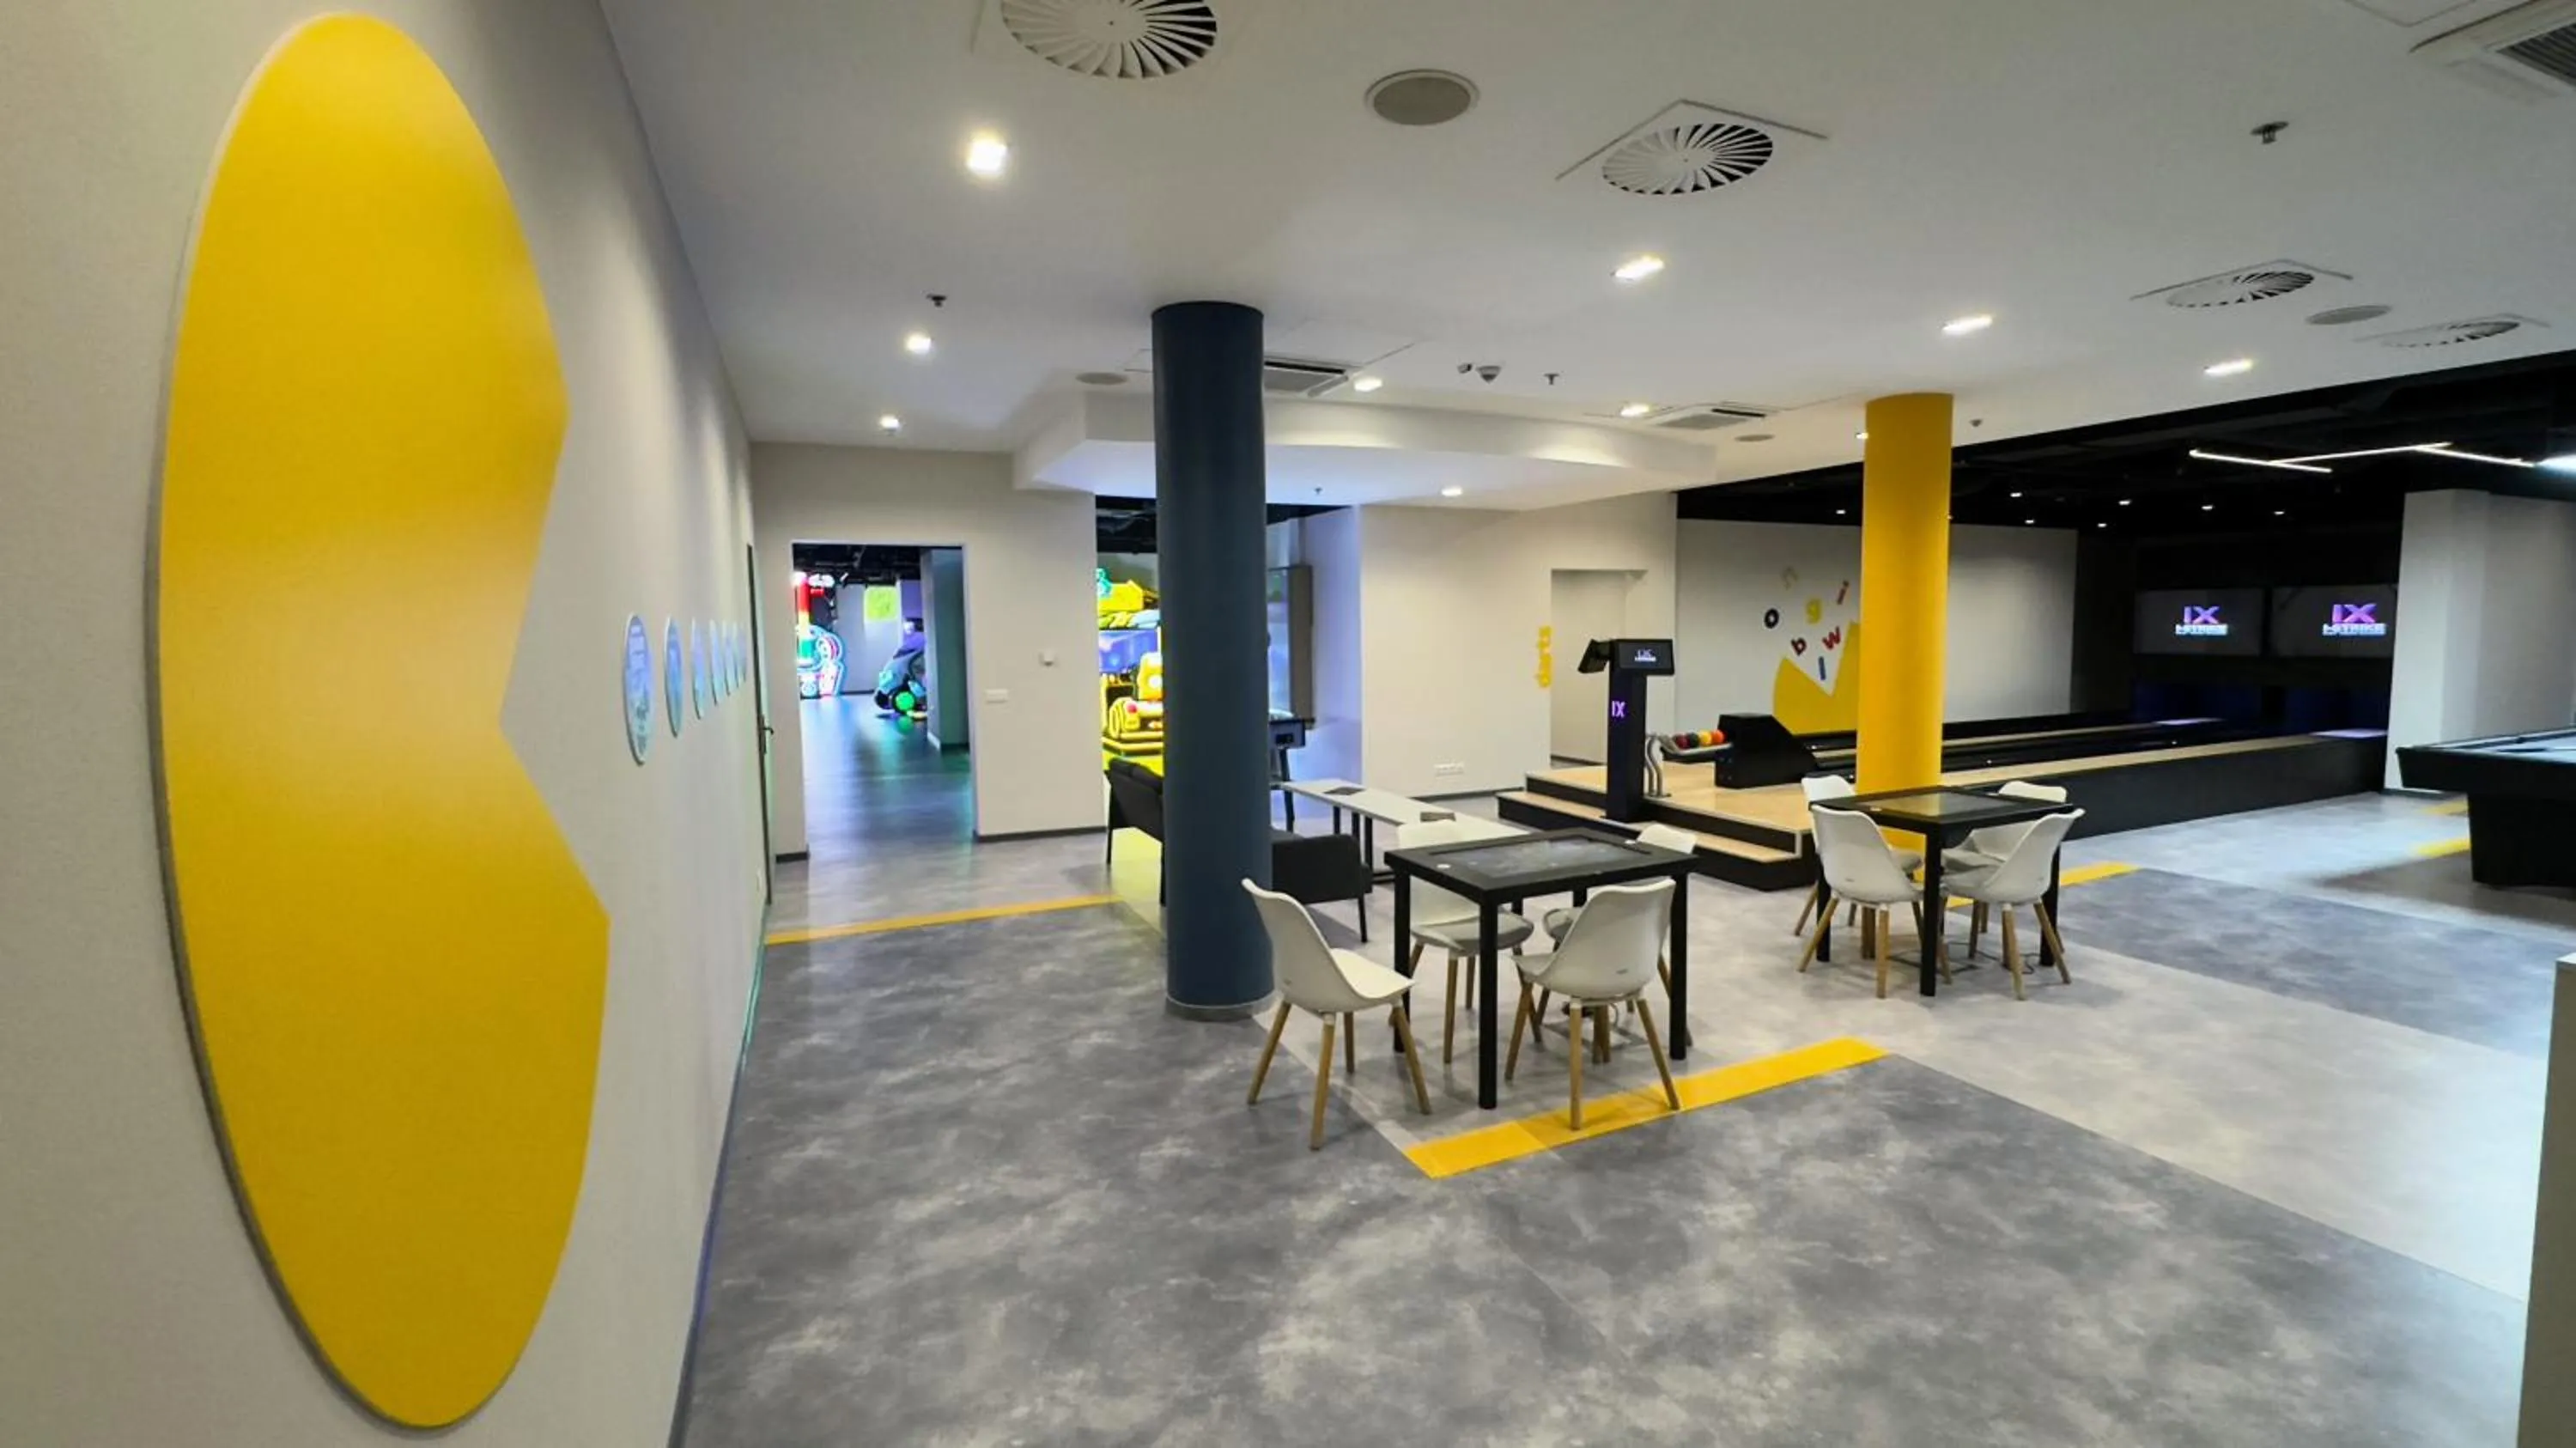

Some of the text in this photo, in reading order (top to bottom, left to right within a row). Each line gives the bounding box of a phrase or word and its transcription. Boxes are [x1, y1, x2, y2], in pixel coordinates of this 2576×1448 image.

[1837, 580, 1850, 605] i
[2184, 605, 2220, 625] IX
[2331, 603, 2377, 624] IX
[1790, 637, 1807, 656] b
[1612, 700, 1625, 718] IX
